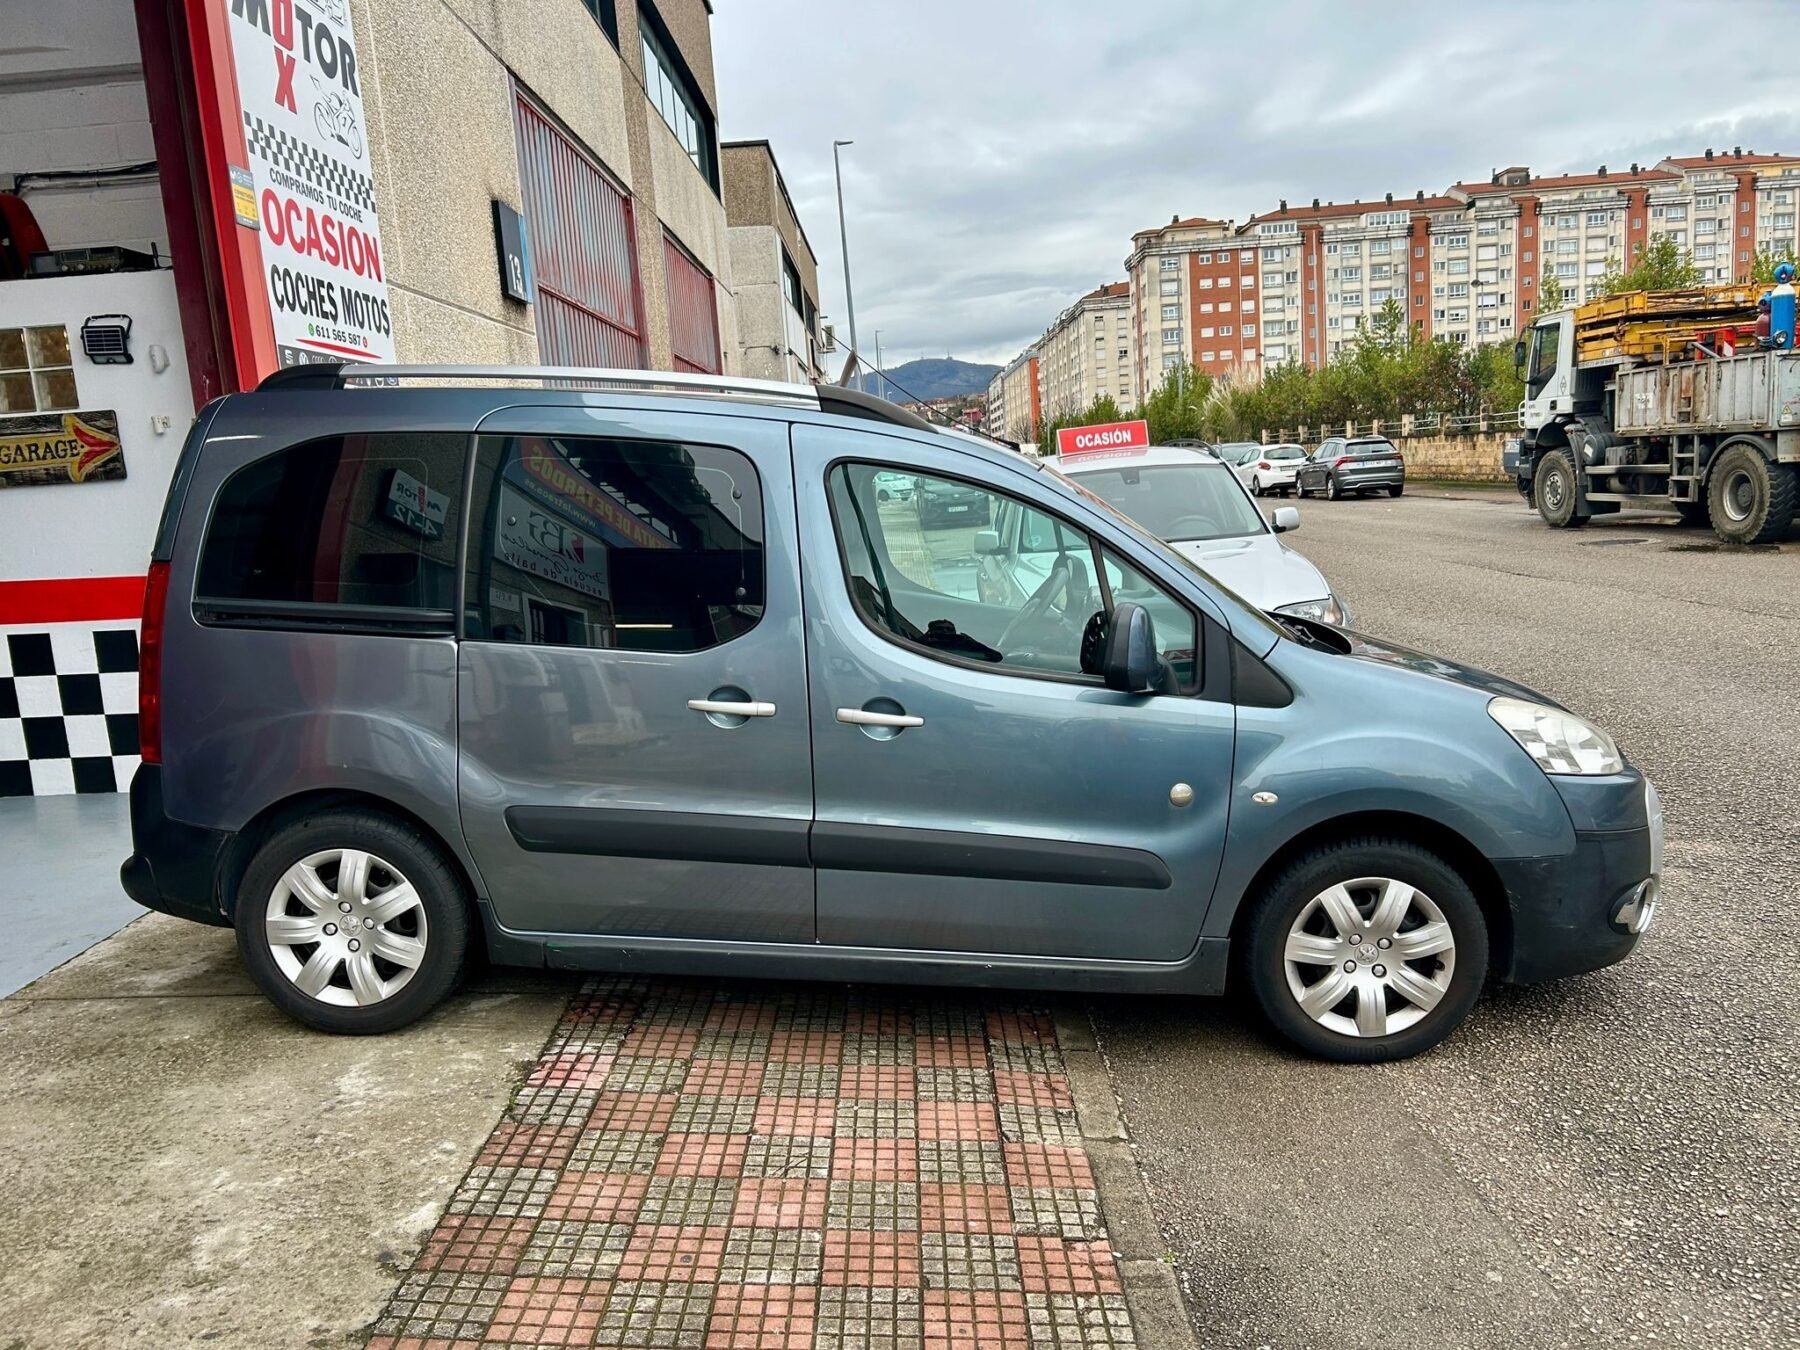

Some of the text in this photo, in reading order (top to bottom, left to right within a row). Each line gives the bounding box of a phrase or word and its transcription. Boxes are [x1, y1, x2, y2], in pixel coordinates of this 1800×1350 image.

[269, 167, 324, 205] COMPRAMOS
[326, 194, 338, 212] TU
[339, 200, 363, 223] COCHE
[261, 188, 382, 283] OCASION
[270, 263, 390, 335] COCHES MOTOS
[315, 324, 361, 346] 611 565 587
[0, 439, 80, 464] GARAGE
[1075, 428, 1132, 448] OCASIÓN
